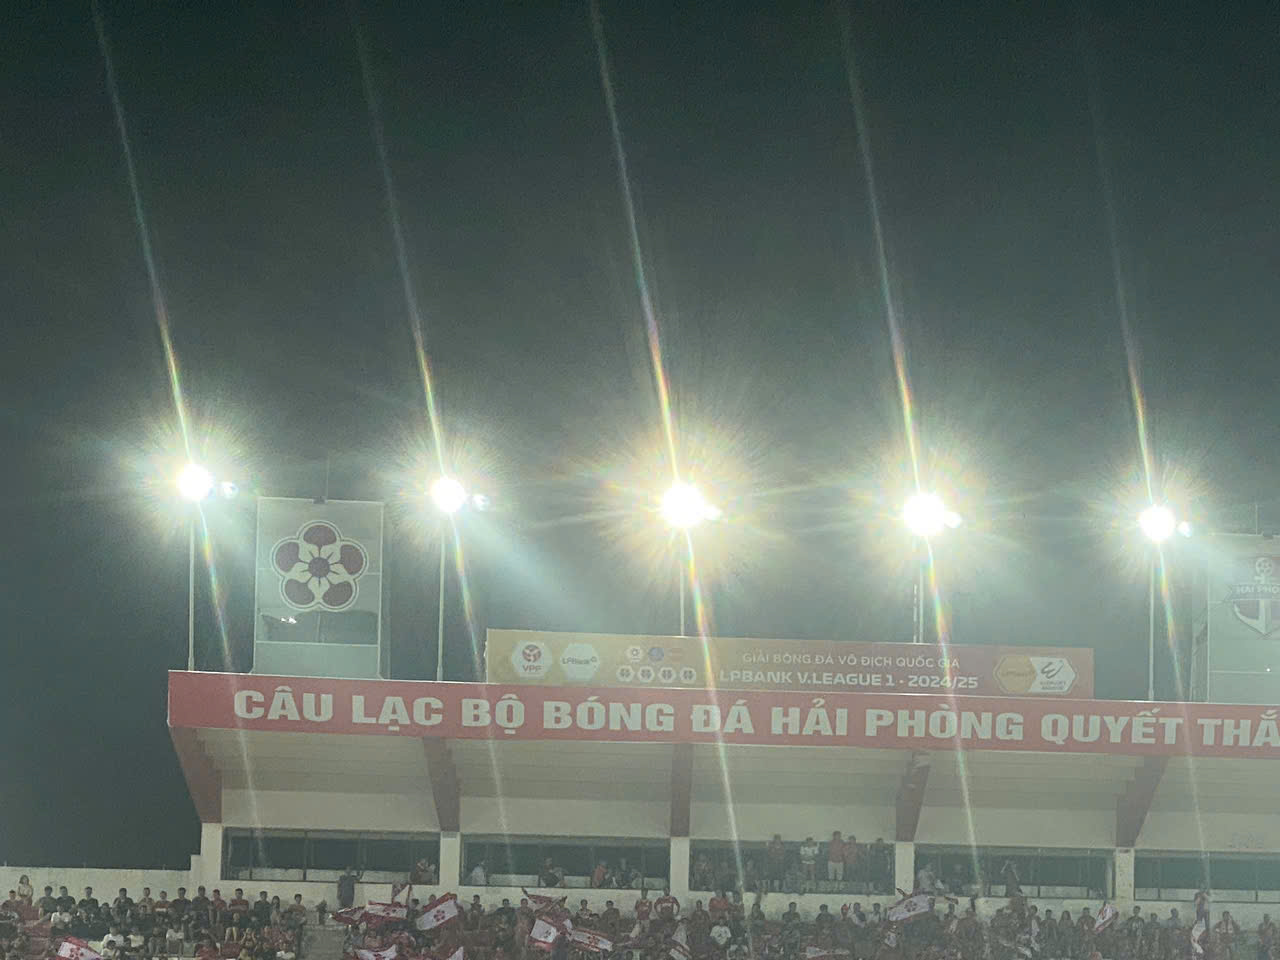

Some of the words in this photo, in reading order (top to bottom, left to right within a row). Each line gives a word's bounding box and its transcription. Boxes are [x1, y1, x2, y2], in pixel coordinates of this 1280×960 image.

[522, 664, 542, 673] VPF
[815, 652, 834, 666] ĐÁ
[861, 655, 892, 668] ĐỊCH
[896, 654, 934, 668] QUỐC
[938, 657, 960, 668] GIA
[719, 669, 793, 684] LPBANK
[797, 672, 881, 687] V.LEAGUE
[886, 674, 895, 686] 1
[908, 675, 979, 689] 2024/25
[233, 685, 333, 722] CÂU
[352, 695, 444, 731] LẠC
[461, 693, 525, 735] BỘ
[543, 696, 674, 731] BÓNG
[690, 699, 754, 734] ĐÁ
[771, 698, 848, 737] HẢI
[865, 702, 1024, 741] PHÒNG
[1041, 706, 1183, 745] QUYẾT
